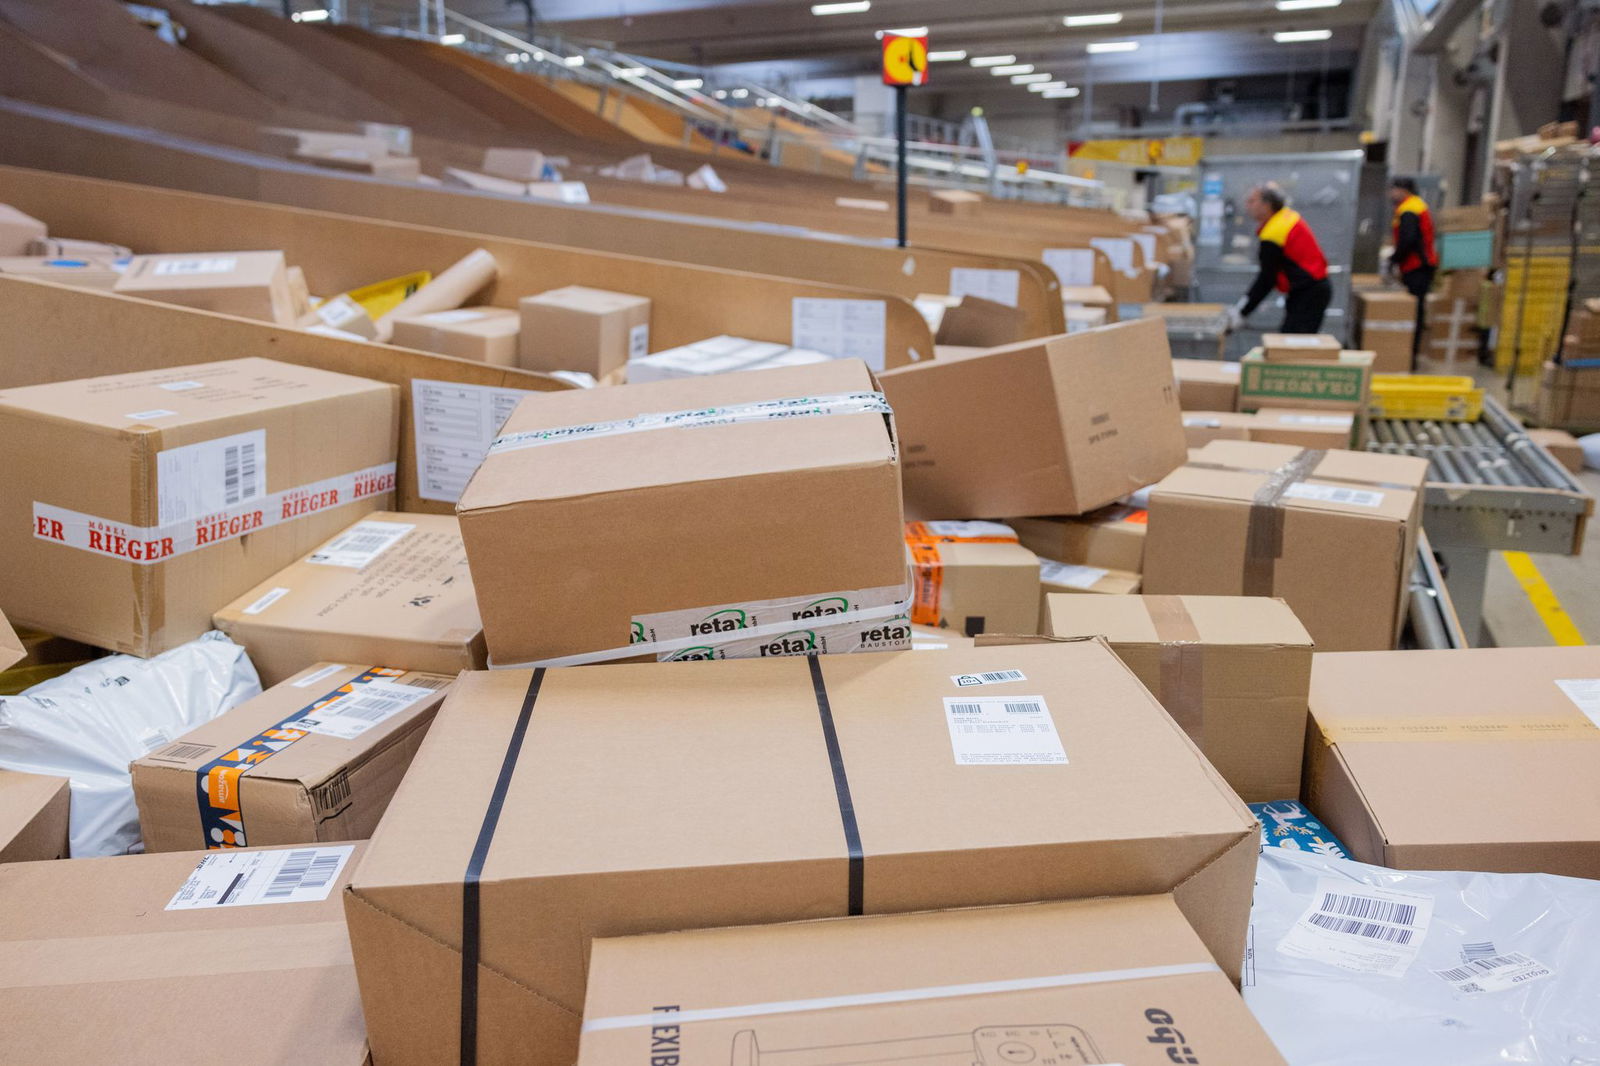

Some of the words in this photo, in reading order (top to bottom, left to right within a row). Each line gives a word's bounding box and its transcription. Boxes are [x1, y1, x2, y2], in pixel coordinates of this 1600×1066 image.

[353, 473, 396, 498] RIEGE
[281, 489, 338, 519] RIEGER
[35, 516, 65, 541] ER
[88, 520, 126, 537] MÖBEL
[195, 511, 263, 545] RIEGER
[88, 530, 174, 561] RIEGER
[690, 616, 748, 636] retax
[760, 635, 818, 656] retax
[651, 1005, 680, 1066] FEXIB
